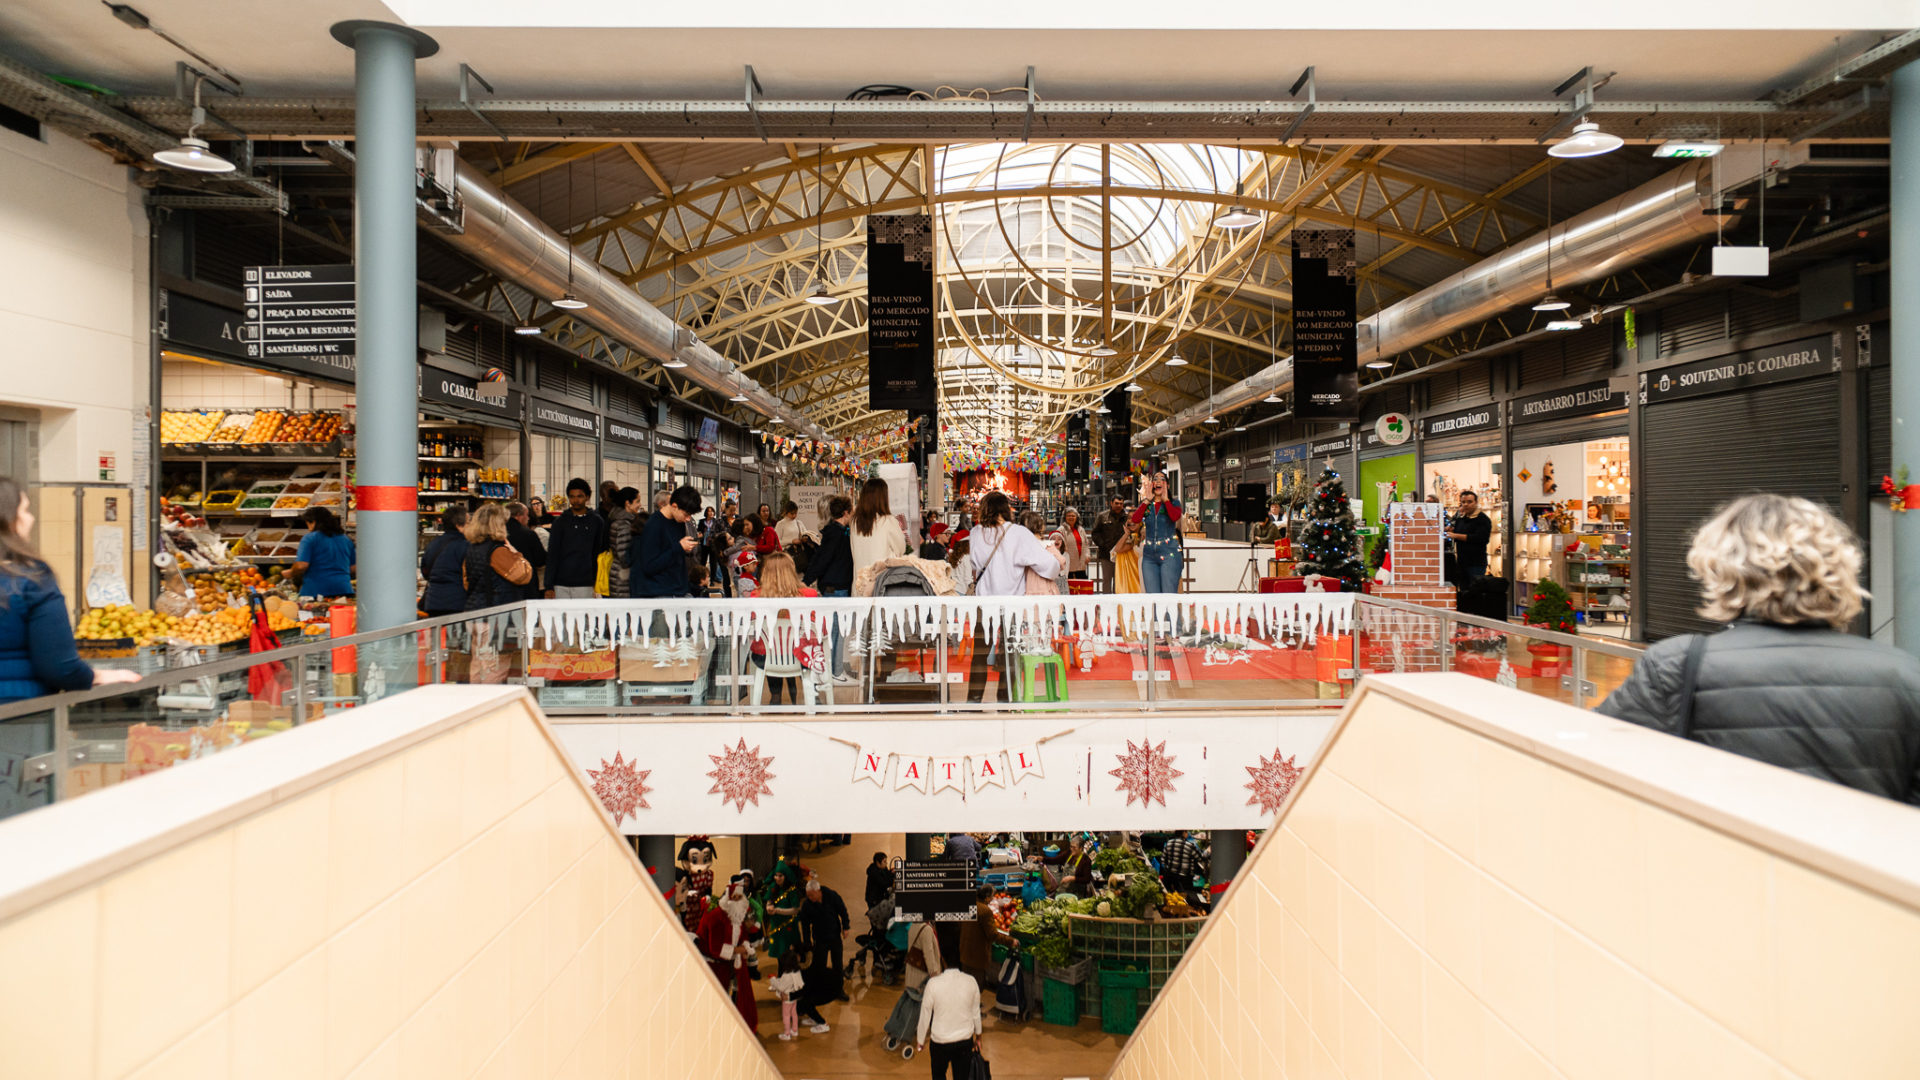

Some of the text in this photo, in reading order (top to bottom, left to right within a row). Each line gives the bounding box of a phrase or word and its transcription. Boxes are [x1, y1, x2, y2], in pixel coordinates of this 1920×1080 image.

[265, 271, 312, 279] ELEVADOR
[265, 289, 292, 298] SAÍDA
[266, 309, 295, 318] PRAÇA
[871, 307, 930, 315] AO MERCADO
[871, 319, 920, 327] MUNICIPAL
[1310, 321, 1353, 329] MERCADO
[220, 322, 234, 340] A
[266, 327, 295, 336] PRAÇA
[297, 327, 310, 335] DA
[879, 330, 909, 338] PEDRO
[266, 344, 317, 353] SANITÁRIOS
[324, 344, 339, 352] WC
[1304, 344, 1333, 352] PEDRO
[1679, 349, 1820, 387] SOUVENIR DE COIMBRA
[441, 380, 449, 394] O
[449, 383, 475, 401] CABAZ
[1522, 387, 1611, 416] ART&BARRO ELISEU
[1431, 411, 1490, 434] ATELIER CERÂMICO
[864, 751, 1033, 780] NATAL
